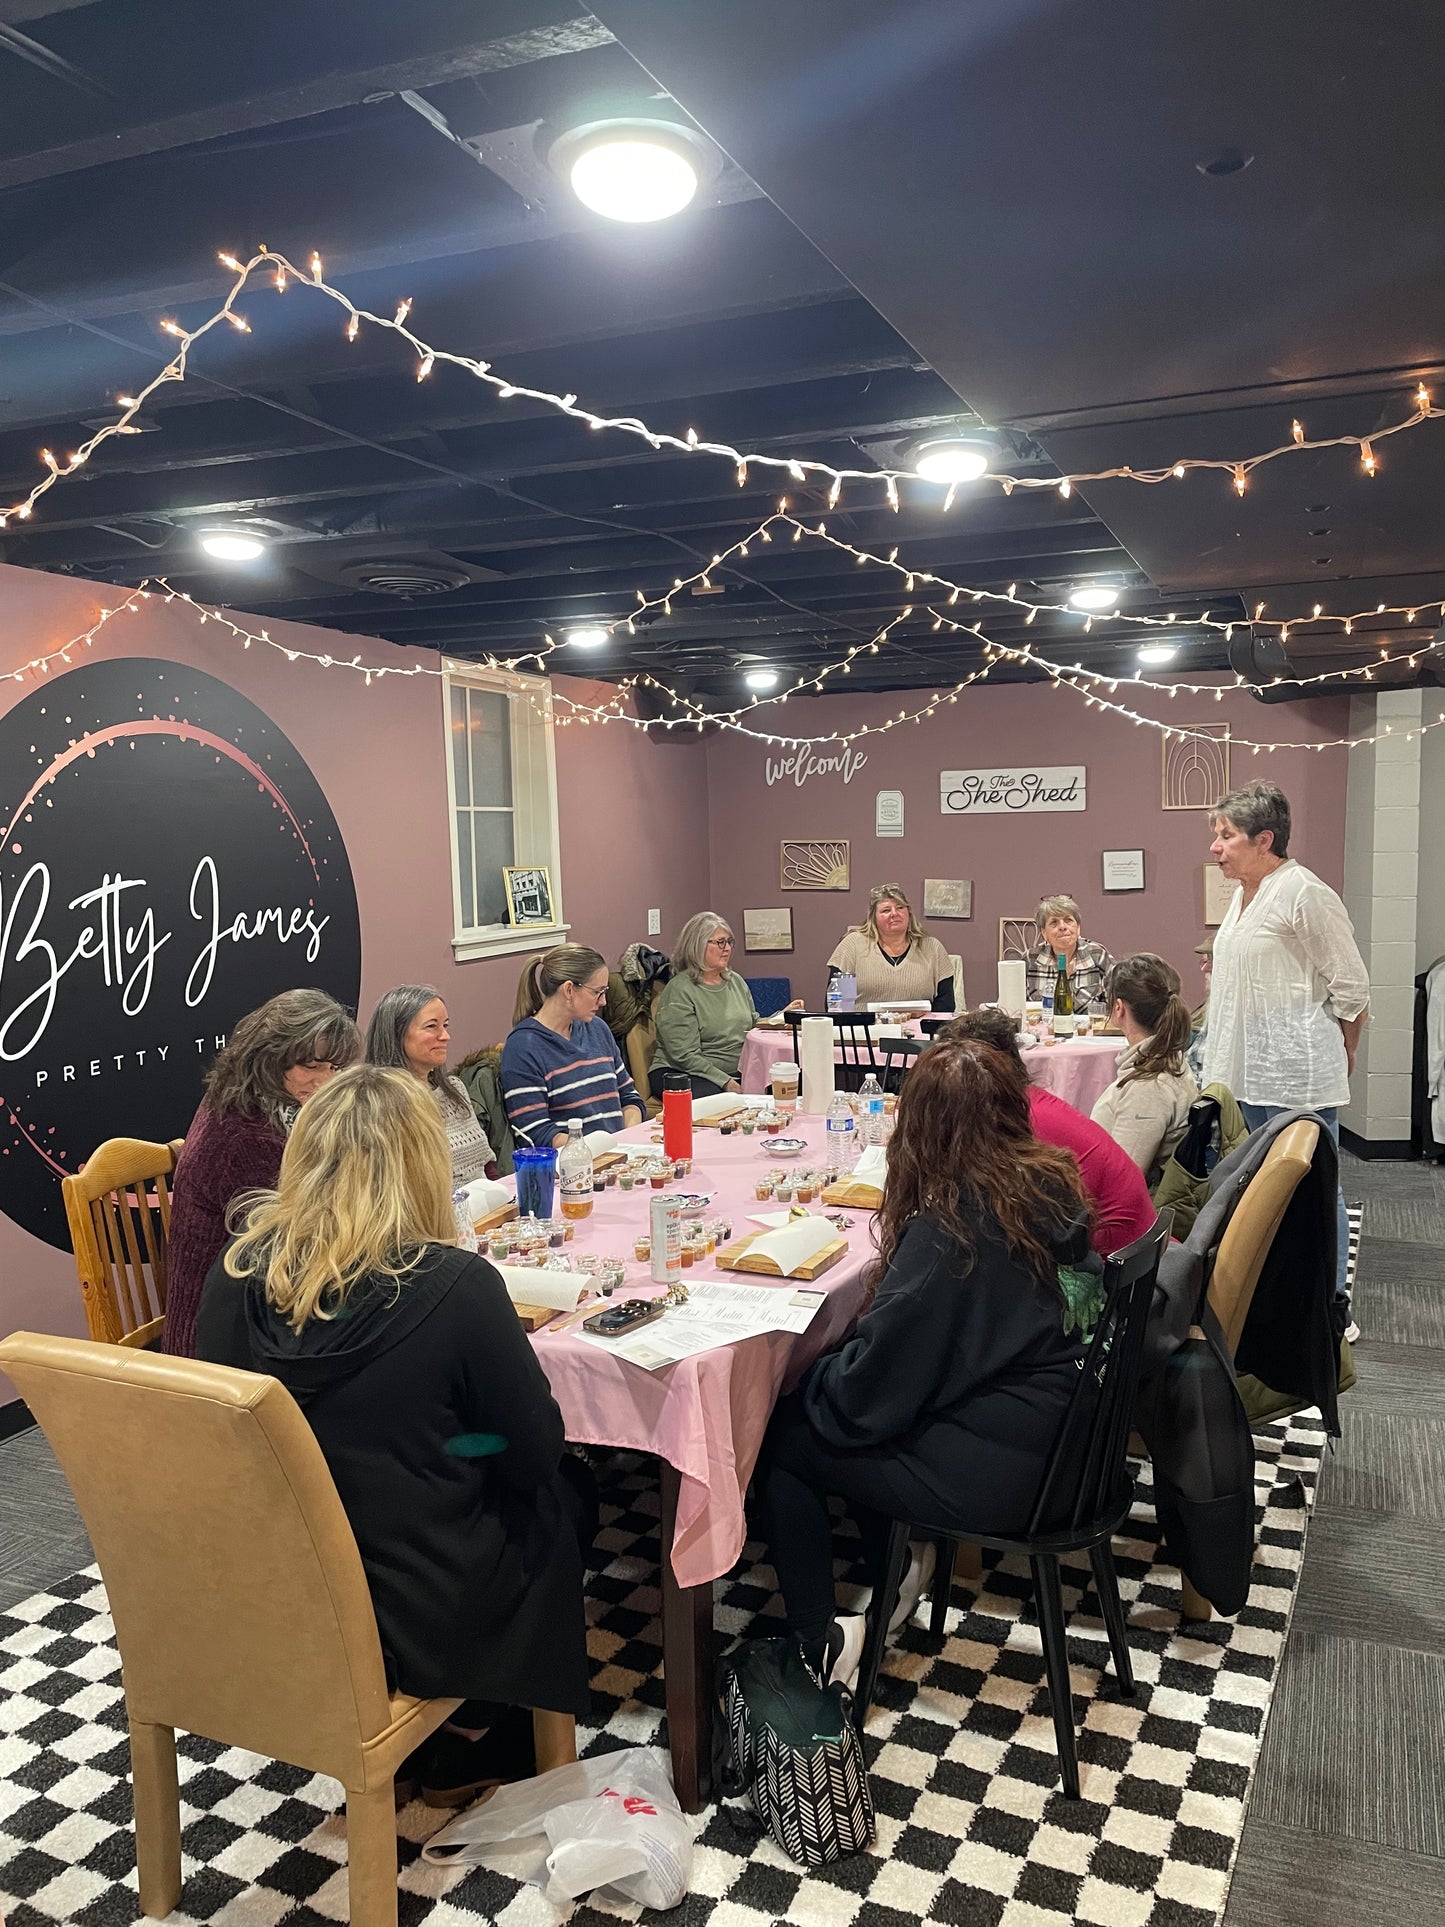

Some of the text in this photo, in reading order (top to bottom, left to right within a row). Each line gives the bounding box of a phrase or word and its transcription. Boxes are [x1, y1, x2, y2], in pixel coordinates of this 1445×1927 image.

[765, 742, 868, 787] welcome
[990, 775, 1016, 789] The
[947, 773, 1078, 811] She Shed
[0, 856, 330, 1061] Betty James
[36, 1034, 227, 1088] PRETTY TH
